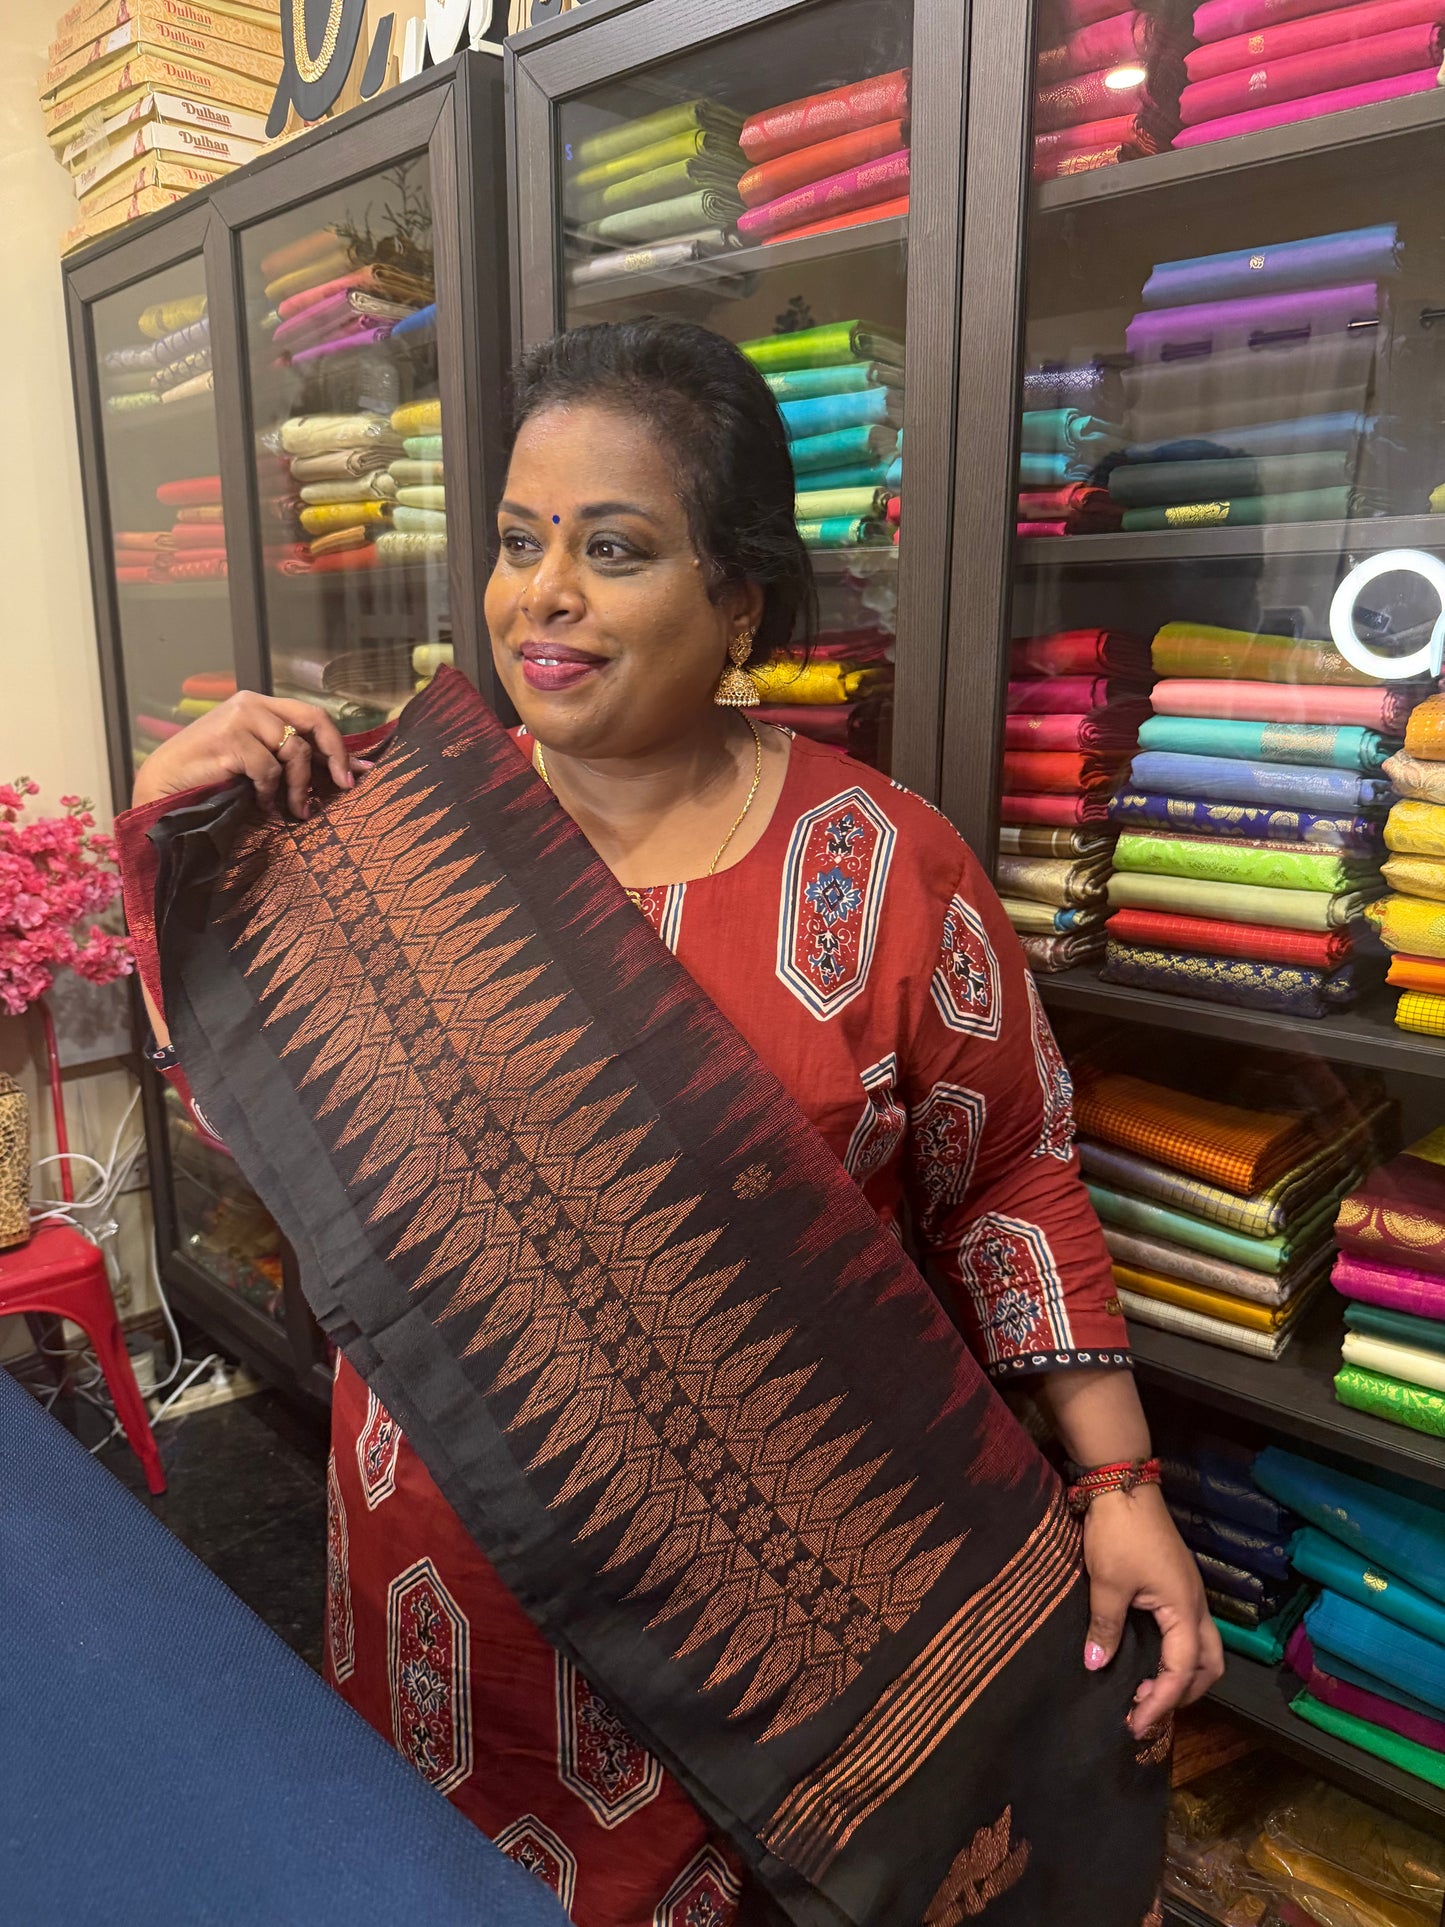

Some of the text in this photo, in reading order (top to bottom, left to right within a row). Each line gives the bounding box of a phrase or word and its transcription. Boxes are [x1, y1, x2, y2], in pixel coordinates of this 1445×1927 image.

[163, 0, 212, 25] Dulhan
[156, 23, 206, 50] Dulhan
[162, 63, 211, 87] Dulhan
[181, 101, 231, 124] Dulhan
[178, 130, 229, 152] Dulhan
